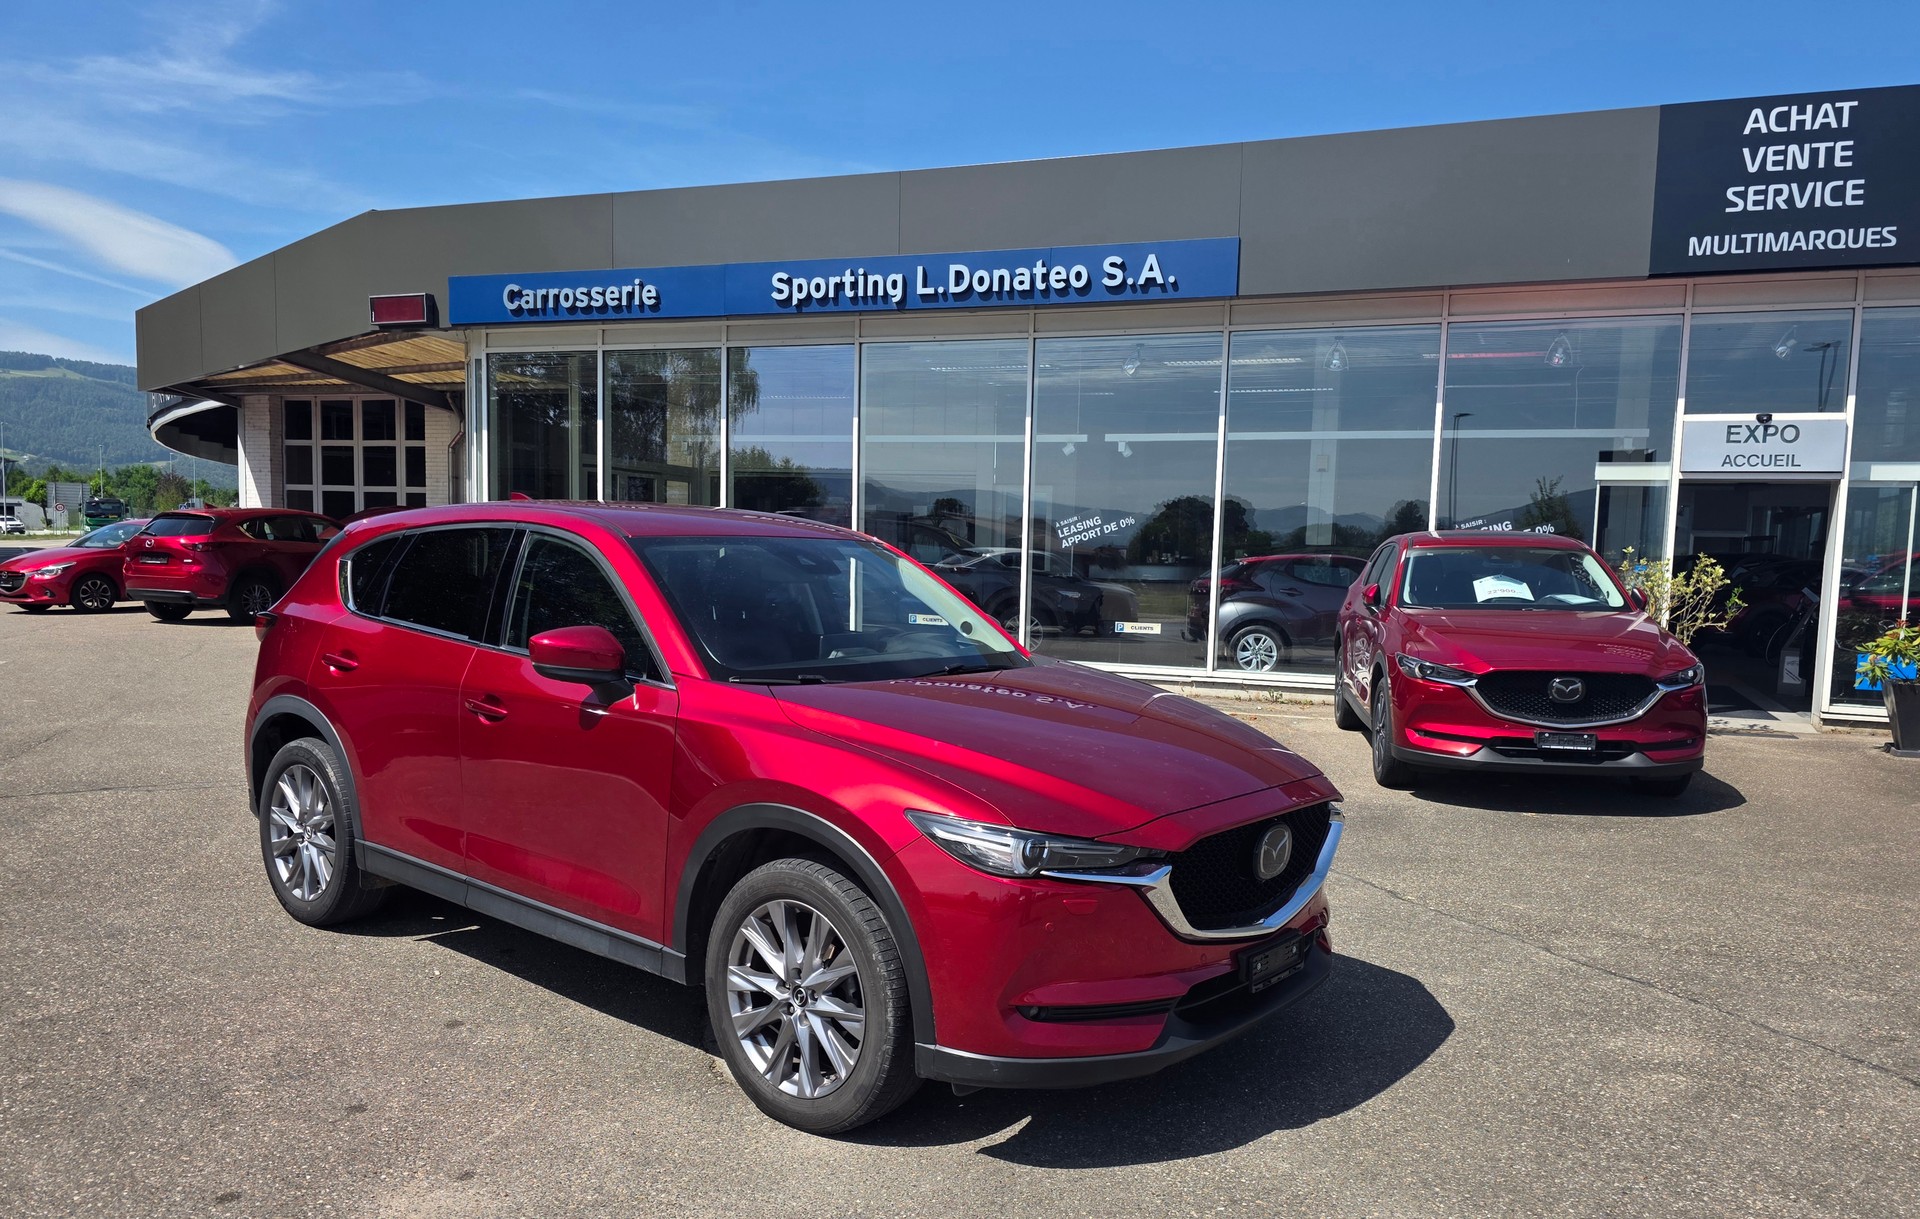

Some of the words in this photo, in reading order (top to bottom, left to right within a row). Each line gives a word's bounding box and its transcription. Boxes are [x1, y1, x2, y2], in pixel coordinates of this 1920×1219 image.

[1742, 101, 1859, 135] ACHAT
[1742, 140, 1854, 173] VENTE
[1725, 179, 1866, 213] SERVICE
[1688, 226, 1898, 257] MULTIMARQUES
[502, 278, 658, 310] Carrosserie
[770, 267, 904, 306] Sporting
[916, 259, 1089, 295] L.Donateo
[1101, 253, 1176, 287] S.A.
[1725, 424, 1801, 444] EXPO
[1721, 454, 1802, 467] ACCUEIL
[1057, 516, 1102, 538] LEASING
[1061, 527, 1101, 548] APPORT
[1103, 522, 1119, 534] DE
[1119, 516, 1136, 528] 0%
[1460, 519, 1483, 529] SAISIR
